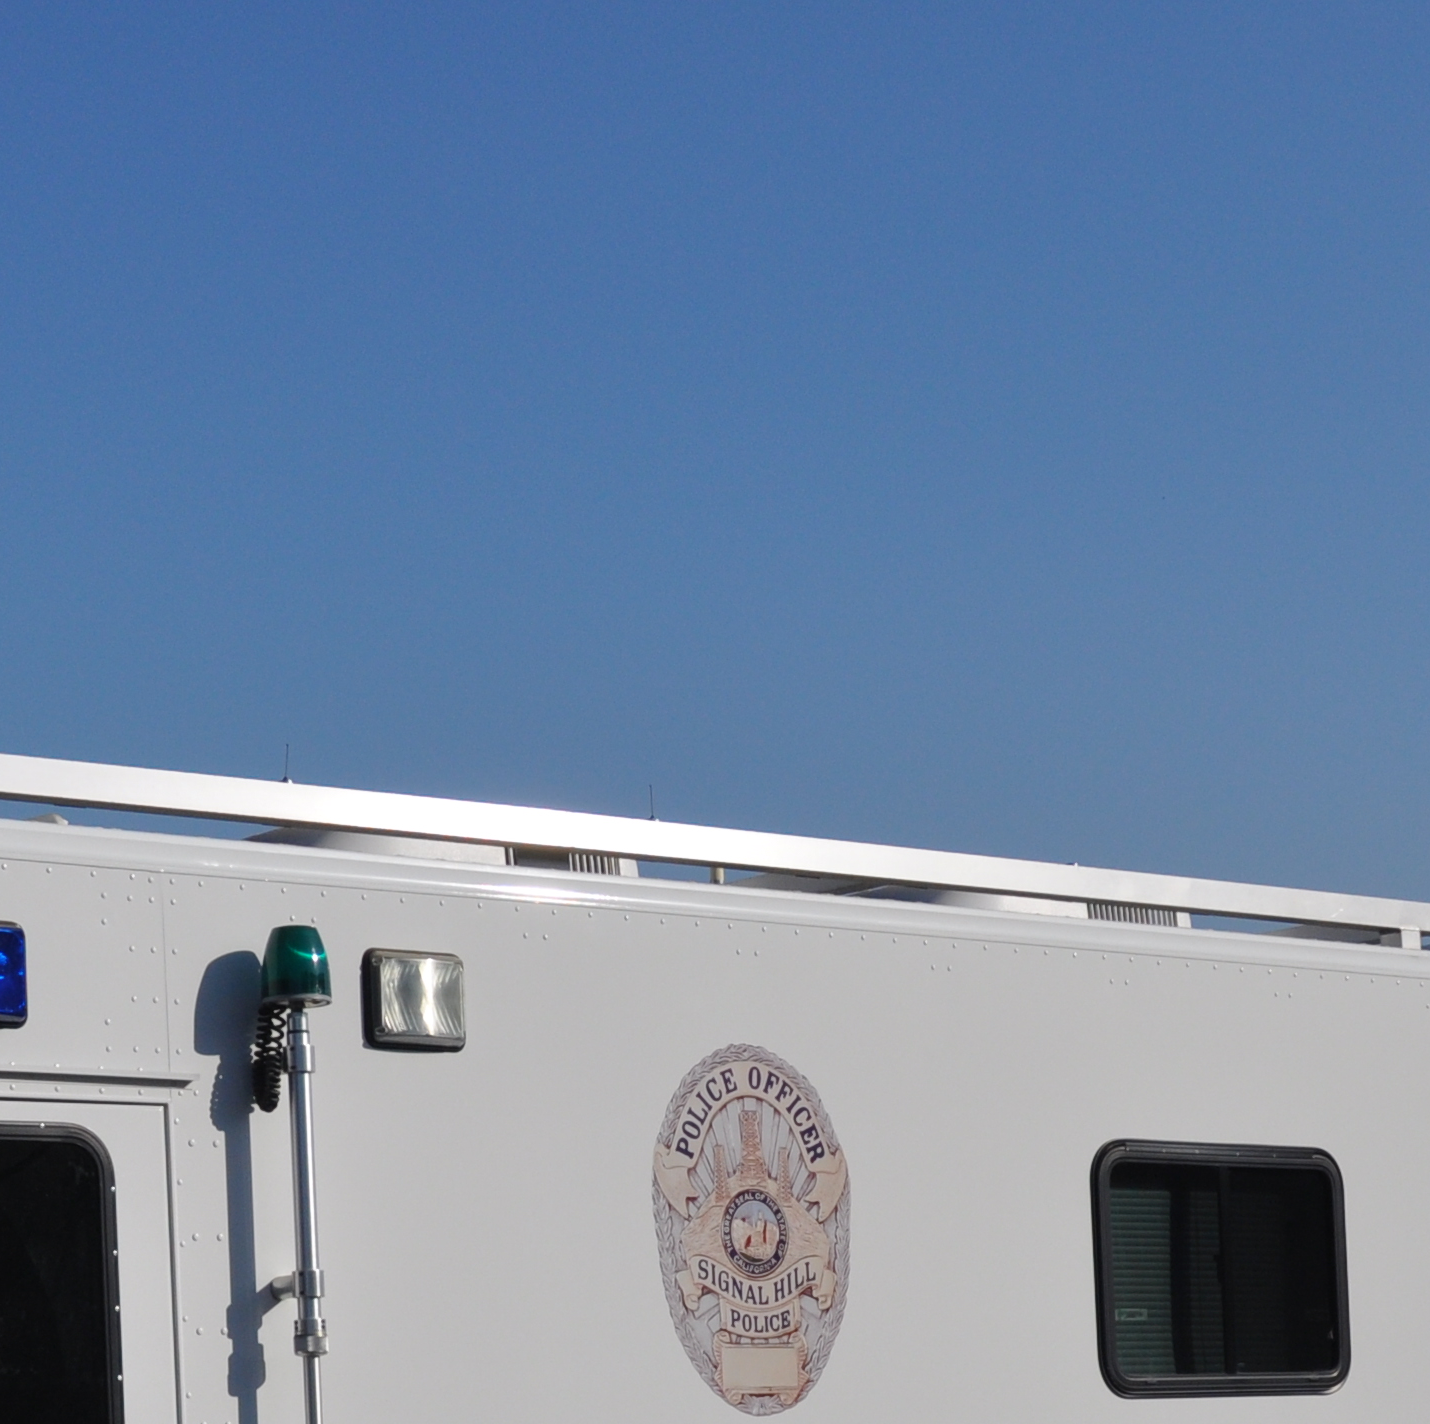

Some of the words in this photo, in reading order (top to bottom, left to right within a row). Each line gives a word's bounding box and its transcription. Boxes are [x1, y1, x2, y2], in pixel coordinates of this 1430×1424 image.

[675, 1067, 738, 1160] POLICE
[748, 1066, 826, 1164] OFFICER
[697, 1259, 769, 1305] SIGNAL
[773, 1261, 816, 1302] HILL
[730, 1308, 791, 1333] POLICE
